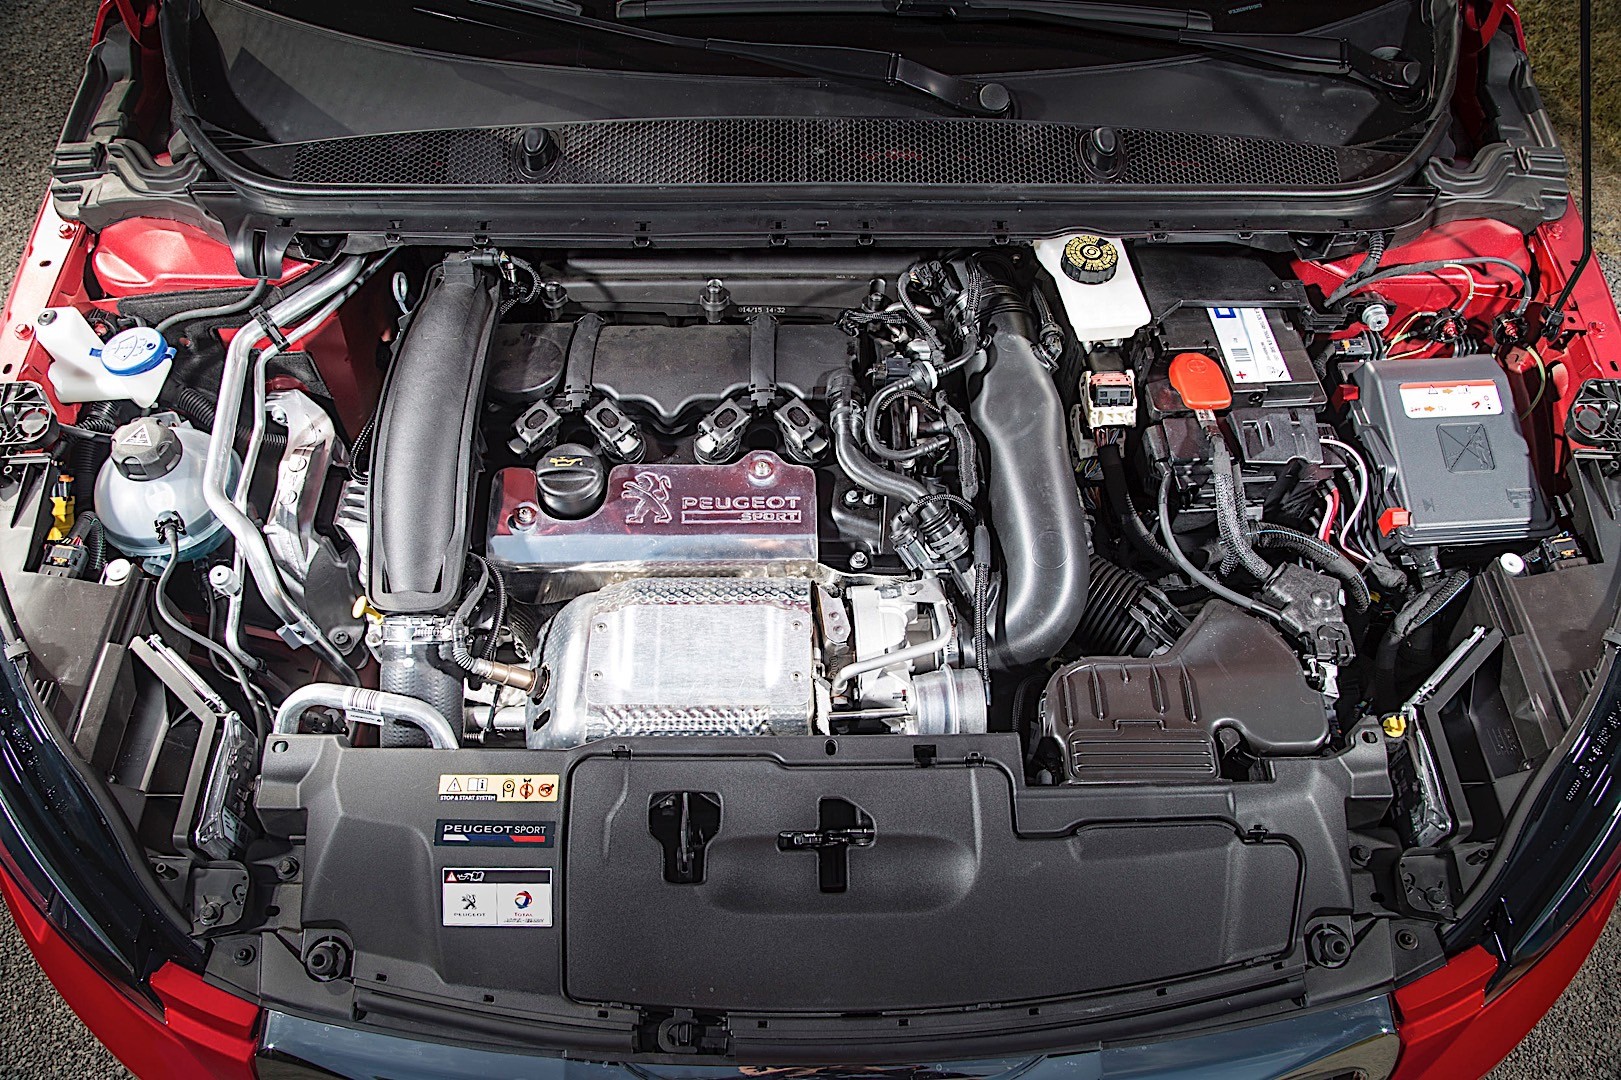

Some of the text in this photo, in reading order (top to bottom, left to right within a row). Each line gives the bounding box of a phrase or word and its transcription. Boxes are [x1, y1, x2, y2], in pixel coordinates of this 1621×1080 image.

[681, 496, 801, 510] PEUGEOT
[741, 512, 798, 521] SPORT
[444, 824, 546, 834] PEUGEOT SPORT
